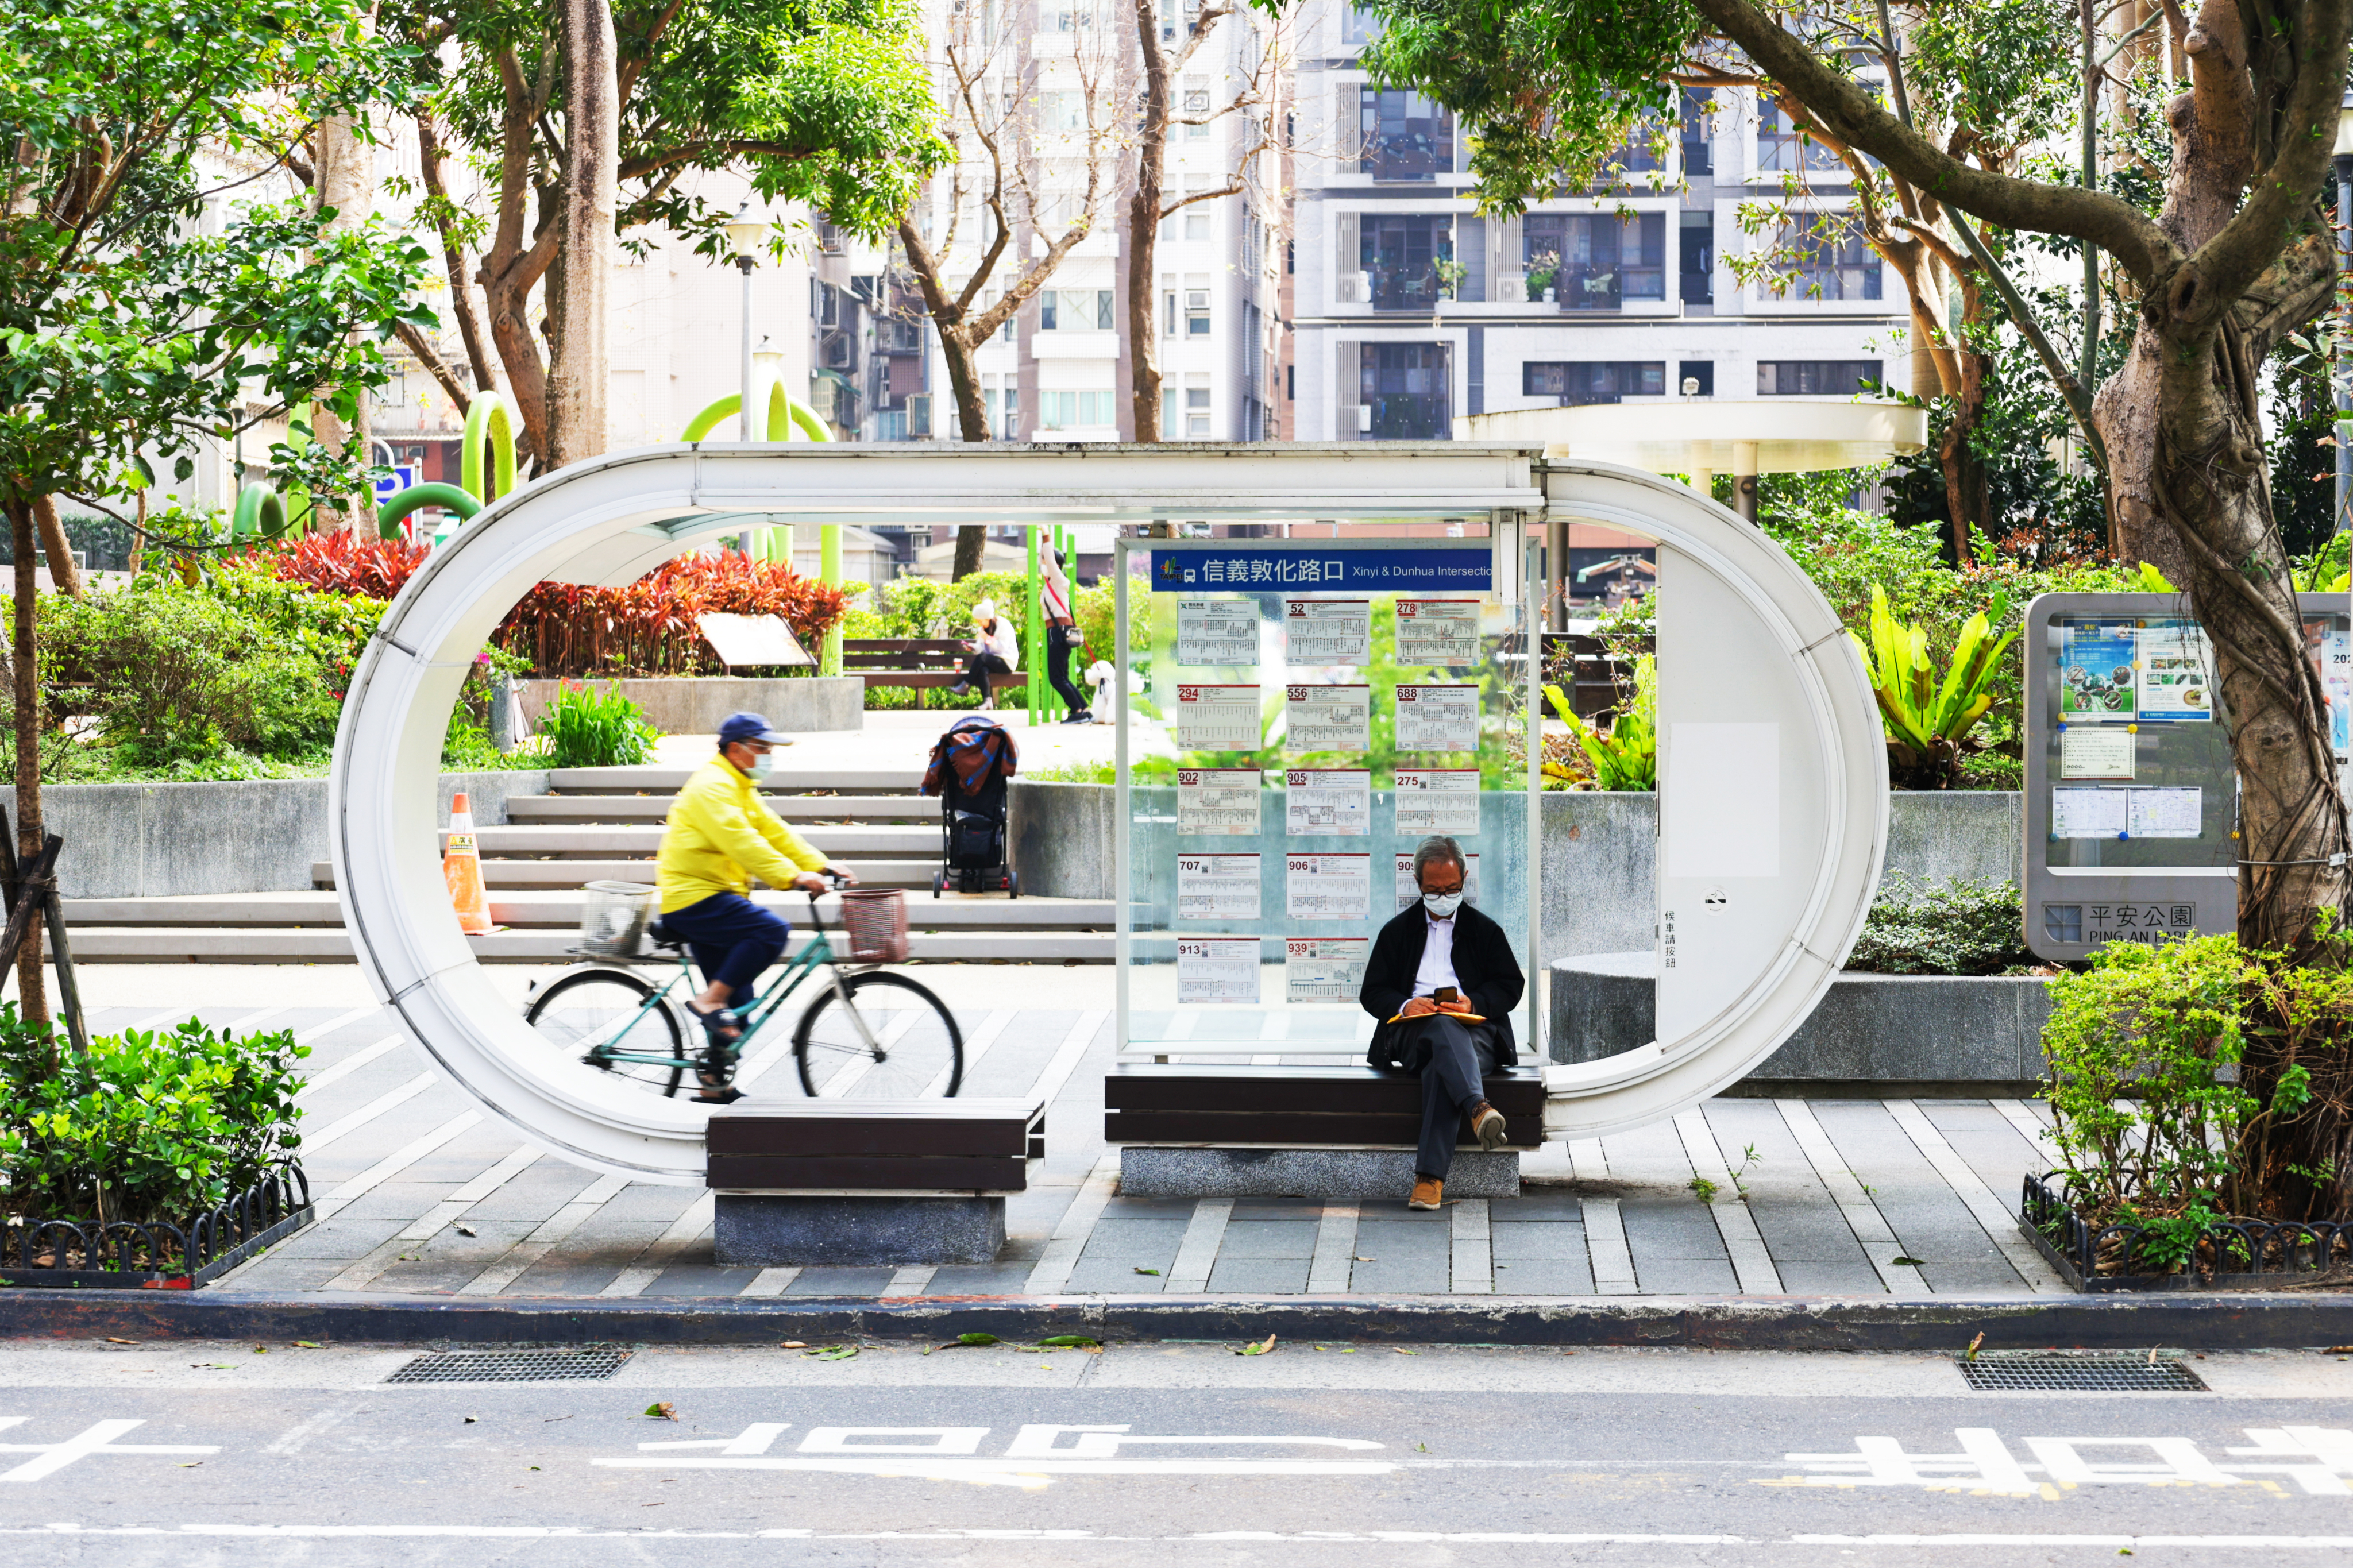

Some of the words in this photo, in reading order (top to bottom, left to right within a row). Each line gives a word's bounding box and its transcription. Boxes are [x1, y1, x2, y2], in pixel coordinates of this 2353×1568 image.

[1203, 559, 1343, 582] 信義敦化路口
[1353, 566, 1378, 578] Xinyi
[1382, 566, 1390, 576] &
[1393, 566, 1434, 576] Dunhua
[1438, 566, 1492, 576] Intersectio
[1291, 604, 1304, 613] 52
[1397, 603, 1415, 613] 278
[1178, 688, 1199, 698] 294
[1287, 688, 1307, 698] 556
[1397, 688, 1417, 698] 688
[1178, 773, 1198, 781] 902
[1287, 773, 1306, 782] 905
[1398, 777, 1418, 786] 275
[1179, 861, 1200, 870] 707
[1289, 861, 1308, 870] 906
[2089, 905, 2192, 927] 平安公園
[1665, 911, 1676, 968] 候車請按鈕
[2090, 931, 2123, 942] PING
[2130, 931, 2148, 942] AN
[1179, 945, 1200, 954] 913
[1288, 943, 1307, 952] 939
